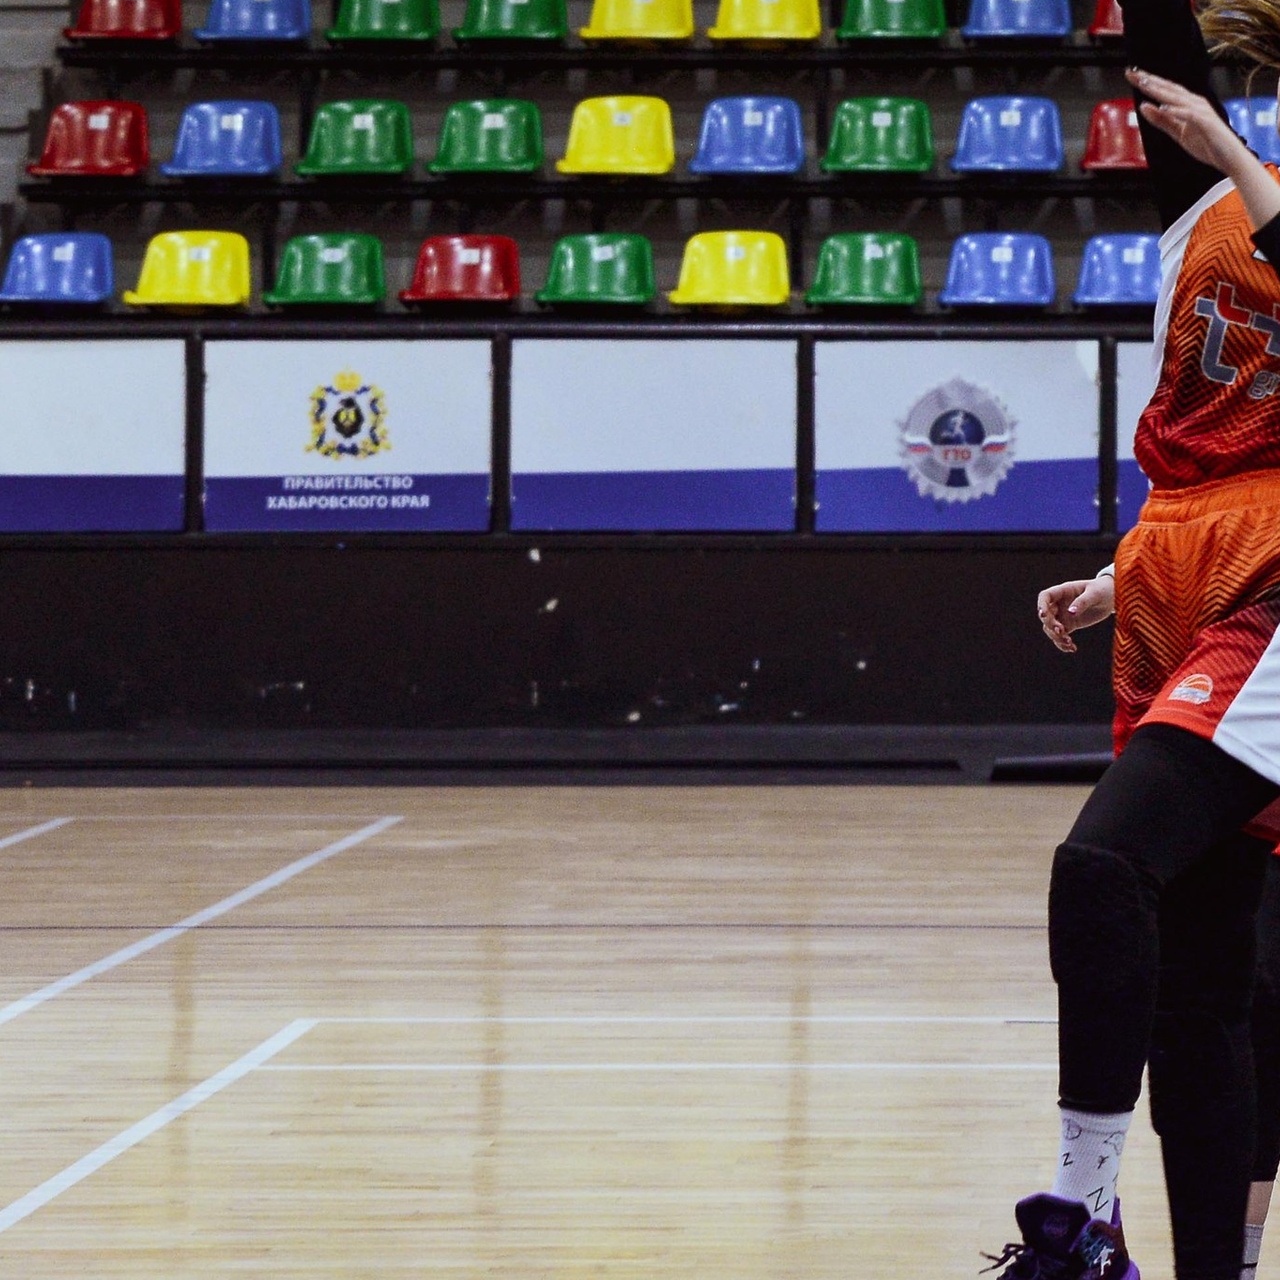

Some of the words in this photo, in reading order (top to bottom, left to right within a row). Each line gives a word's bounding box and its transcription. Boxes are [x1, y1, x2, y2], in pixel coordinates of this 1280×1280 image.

[283, 476, 414, 490] ПРАВИТЕЛЬСТВО
[266, 495, 388, 509] ХАБАРОВСКОГО
[391, 495, 430, 508] КРАЯ
